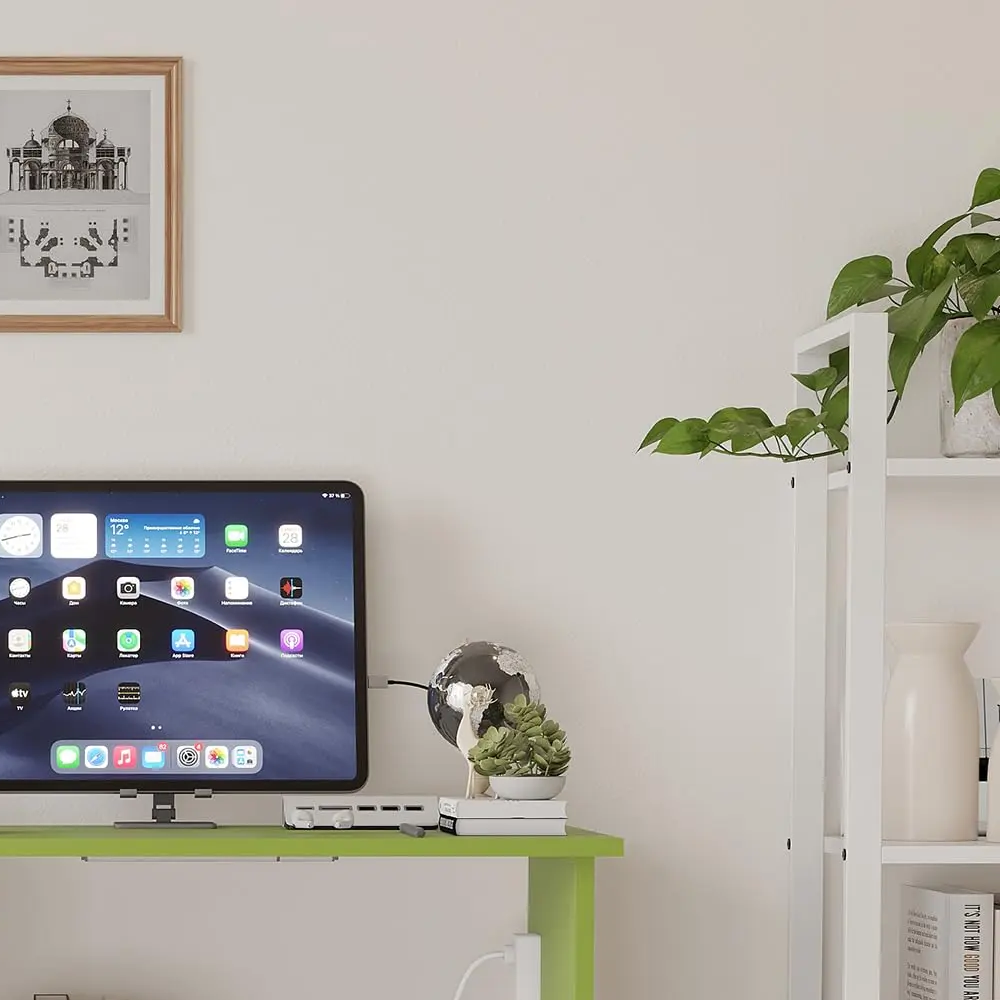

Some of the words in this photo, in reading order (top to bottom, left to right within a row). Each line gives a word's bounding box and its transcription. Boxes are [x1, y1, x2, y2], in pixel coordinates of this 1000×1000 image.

[110, 524, 129, 536] 12°
[282, 532, 299, 544] 28
[964, 904, 981, 918] IT'S
[964, 920, 981, 934] NOT
[963, 936, 980, 952] HOW
[963, 953, 980, 972] GOOD
[963, 974, 979, 989] YOU
